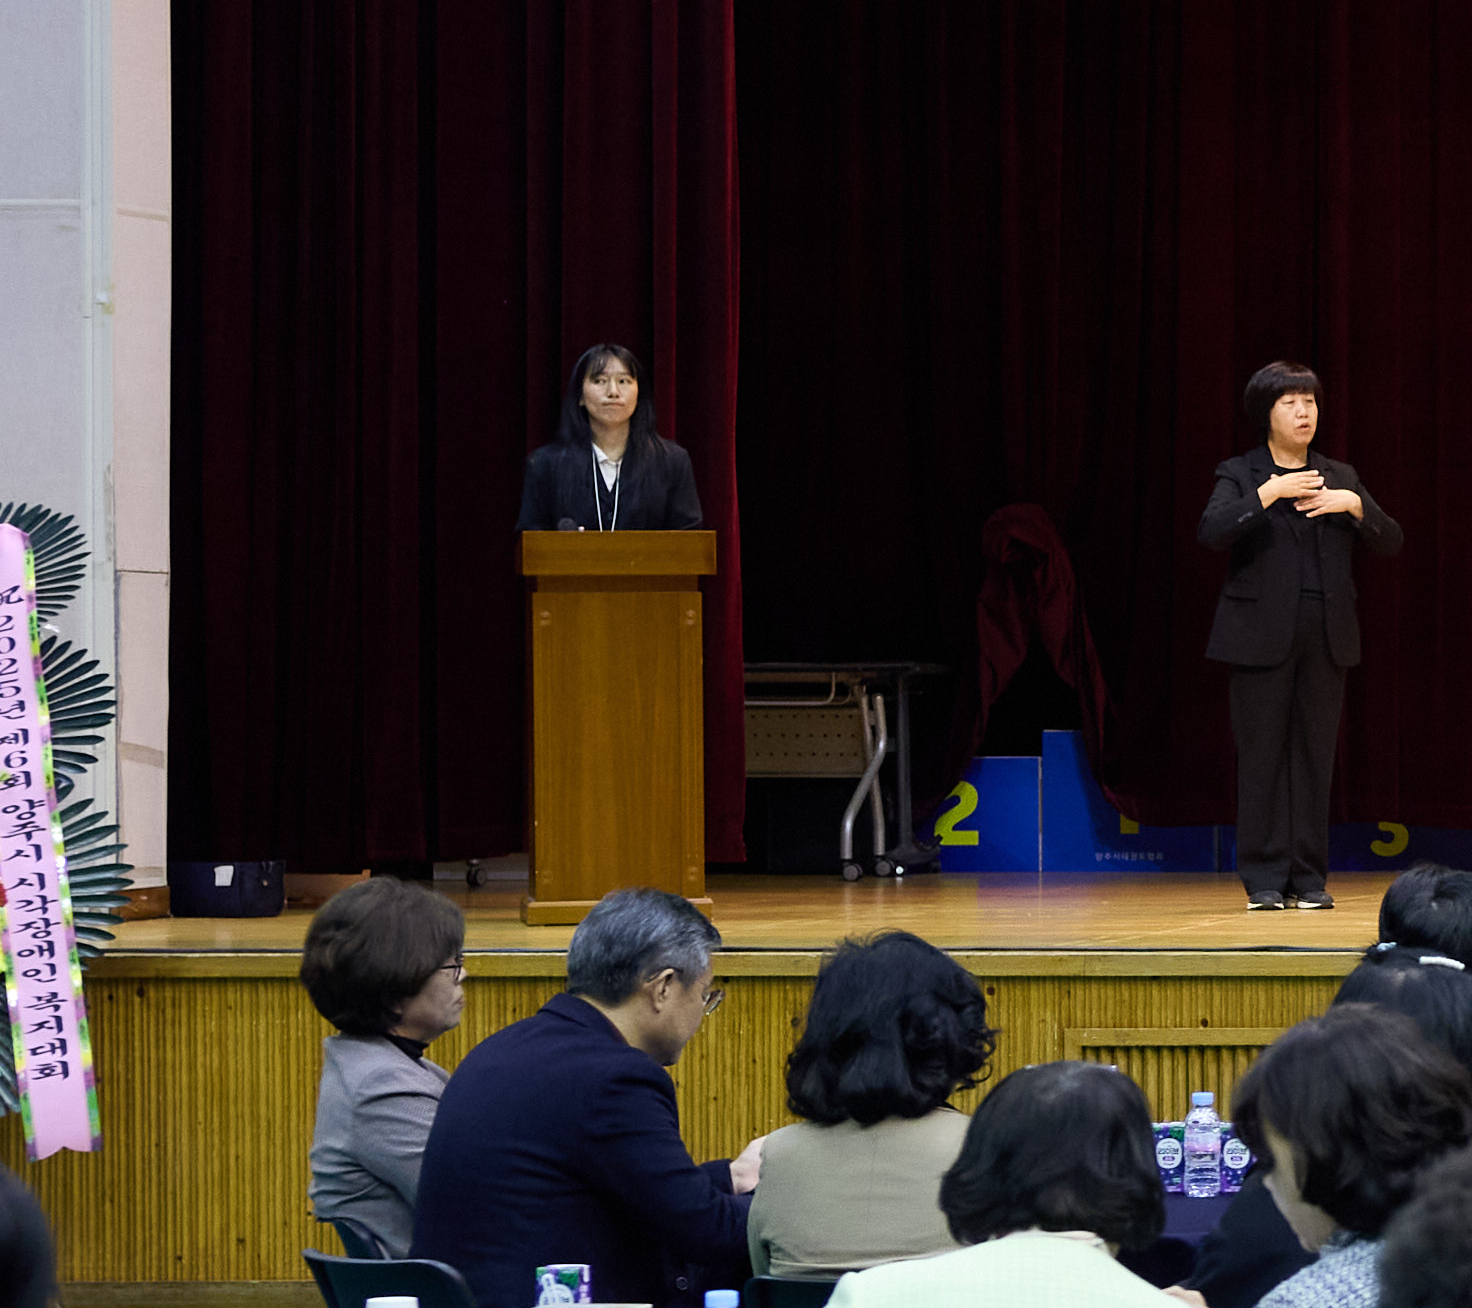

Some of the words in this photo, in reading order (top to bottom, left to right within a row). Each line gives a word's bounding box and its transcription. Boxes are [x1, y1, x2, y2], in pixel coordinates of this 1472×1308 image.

[1, 798, 46, 862] 양주시
[934, 780, 980, 846] 2
[6, 872, 61, 984] 시각장애인
[24, 992, 70, 1082] 복지대회
